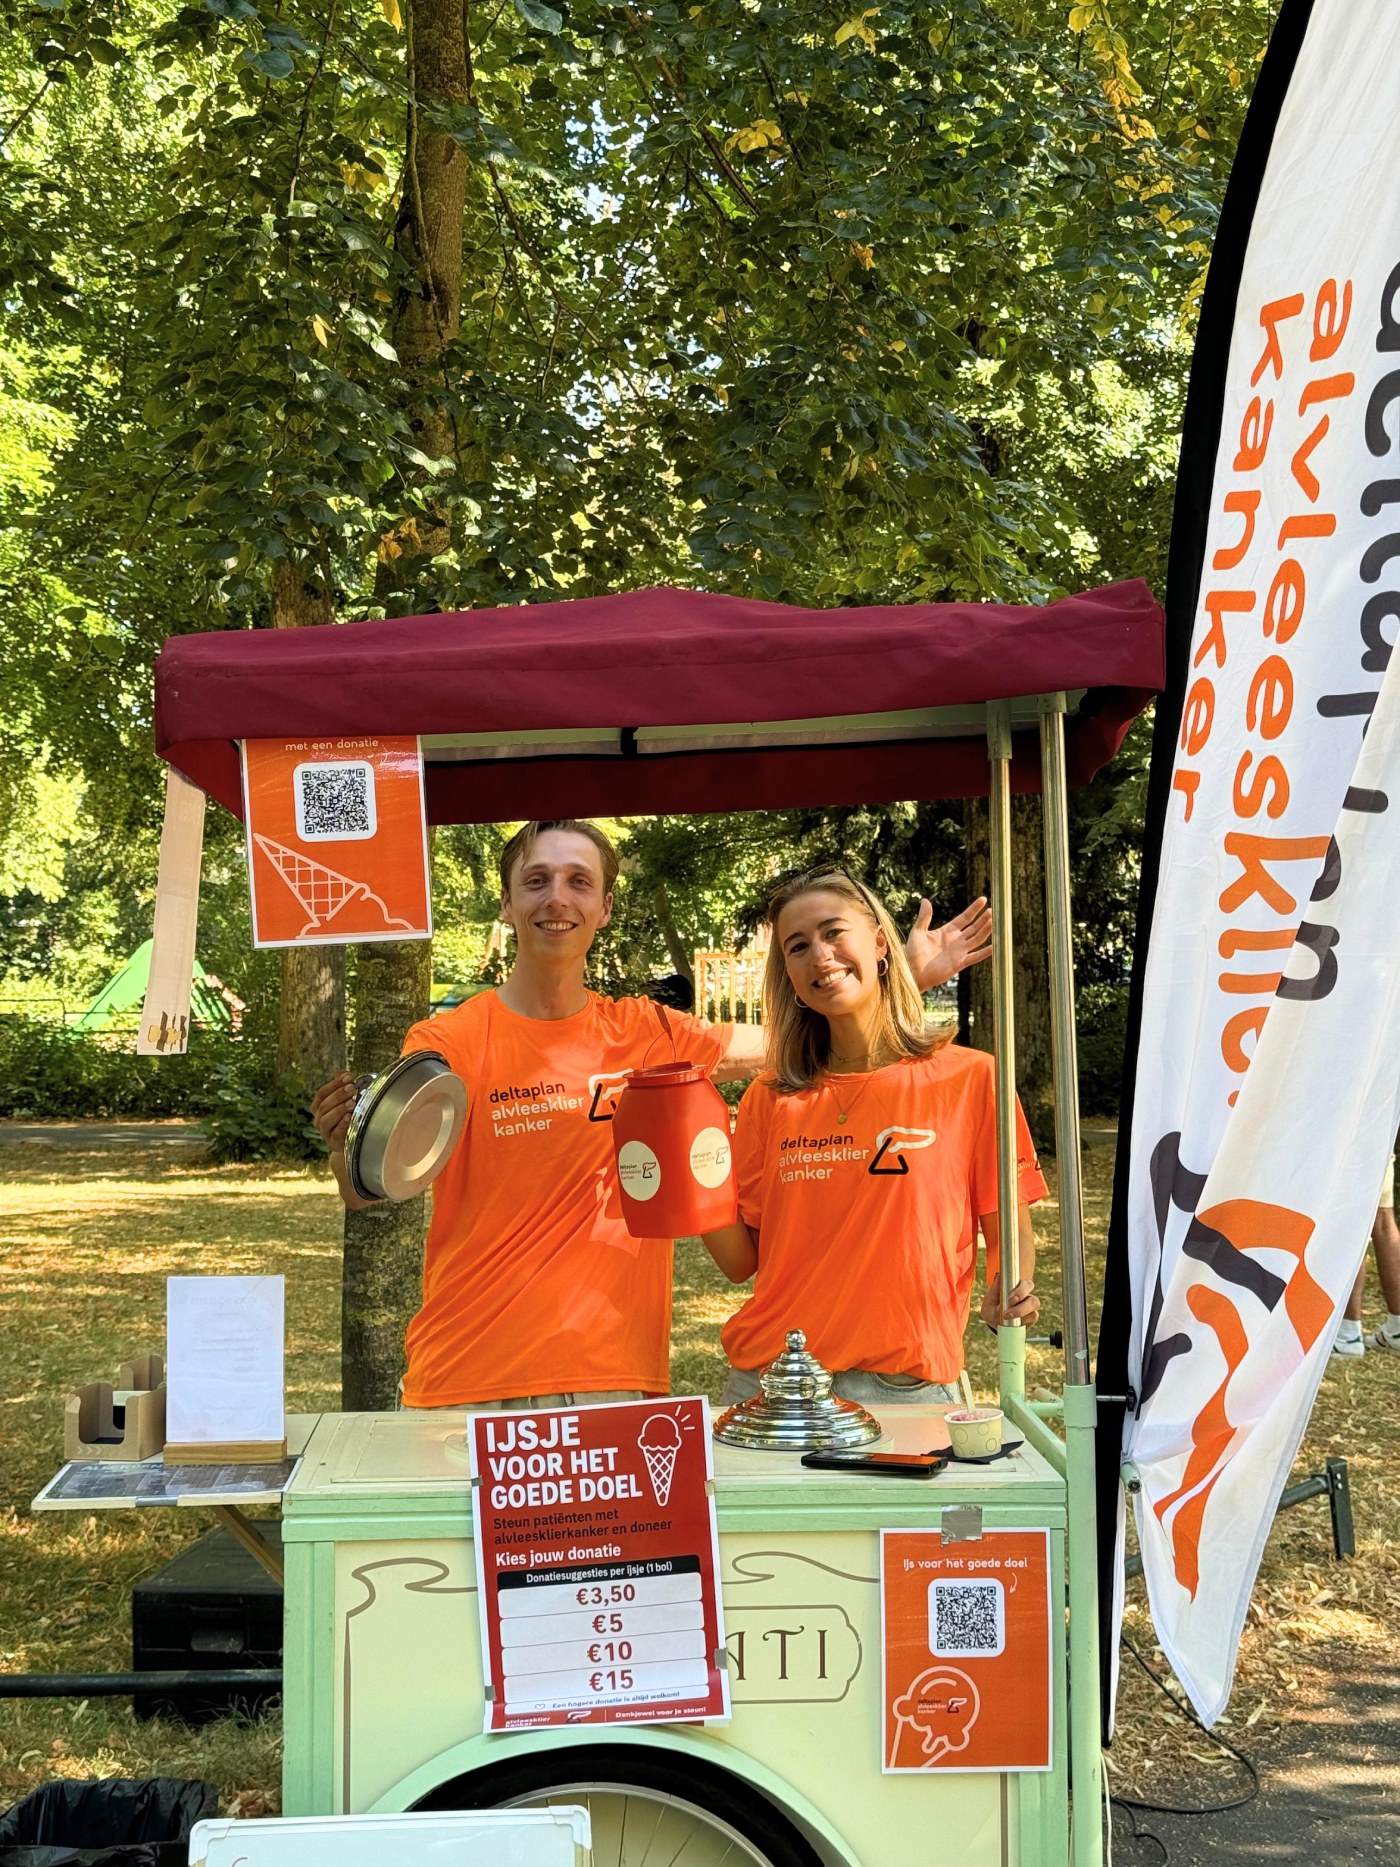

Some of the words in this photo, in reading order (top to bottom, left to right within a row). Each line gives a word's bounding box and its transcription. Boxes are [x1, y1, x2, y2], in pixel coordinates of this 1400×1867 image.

[1173, 292, 1305, 823] kanker
[312, 742, 333, 750] een
[337, 738, 379, 749] donatie
[489, 1081, 566, 1103] deltaplan
[491, 1095, 585, 1121] alvleesklier
[493, 1117, 553, 1138] kanker
[780, 1134, 854, 1151] deltaplan
[779, 1147, 870, 1168] alvleesklier
[780, 1165, 833, 1184] kanker
[486, 1415, 581, 1453] IJSJE
[488, 1453, 564, 1481] VOOR
[570, 1447, 619, 1475] HET
[490, 1479, 574, 1510] GOEDE
[579, 1473, 643, 1502] DOEL
[493, 1517, 530, 1530] Steun
[533, 1511, 592, 1529] patiënten
[595, 1509, 619, 1521] met
[494, 1524, 610, 1545] alvleesklierkanker
[612, 1525, 627, 1535] en
[630, 1520, 672, 1533] doneer
[495, 1552, 527, 1567] Kies
[529, 1547, 564, 1566] jouw
[567, 1543, 622, 1561] donatie
[918, 1560, 942, 1568] voor
[946, 1558, 964, 1568] het
[967, 1557, 1001, 1571] goede
[1004, 1557, 1028, 1568] doel
[526, 1567, 608, 1583] Donatiesuggesties
[610, 1567, 625, 1578] per
[655, 1561, 673, 1572] bol)
[575, 1583, 636, 1607] €3,50
[591, 1613, 623, 1634] €5
[586, 1640, 633, 1663] €10
[588, 1669, 634, 1692] €15
[595, 1697, 622, 1705] donatie
[615, 1709, 655, 1719] Dankjewel
[674, 1708, 682, 1716] je
